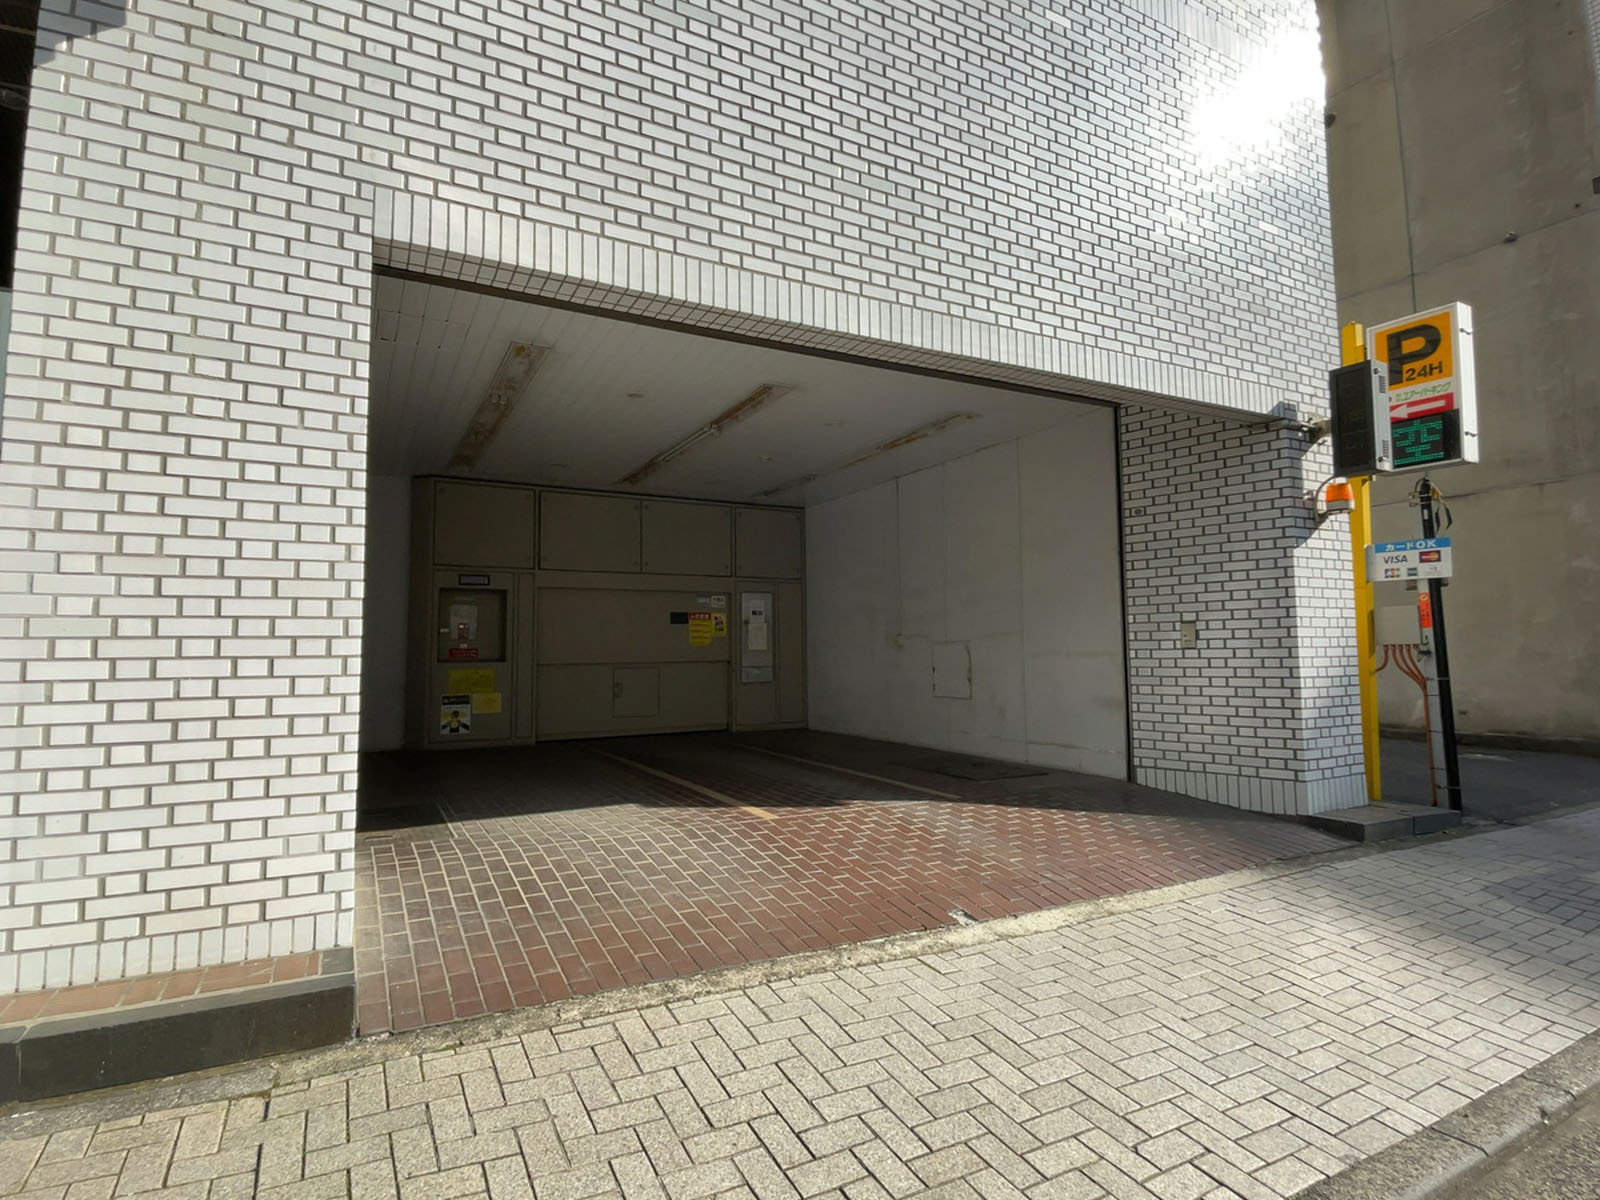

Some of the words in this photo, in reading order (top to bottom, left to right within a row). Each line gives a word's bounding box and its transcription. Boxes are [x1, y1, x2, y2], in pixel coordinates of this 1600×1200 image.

[1387, 324, 1442, 385] P
[1405, 361, 1443, 382] 24H
[1392, 419, 1445, 465] 空
[1385, 539, 1437, 552] カードOK
[1383, 555, 1408, 564] VISA
